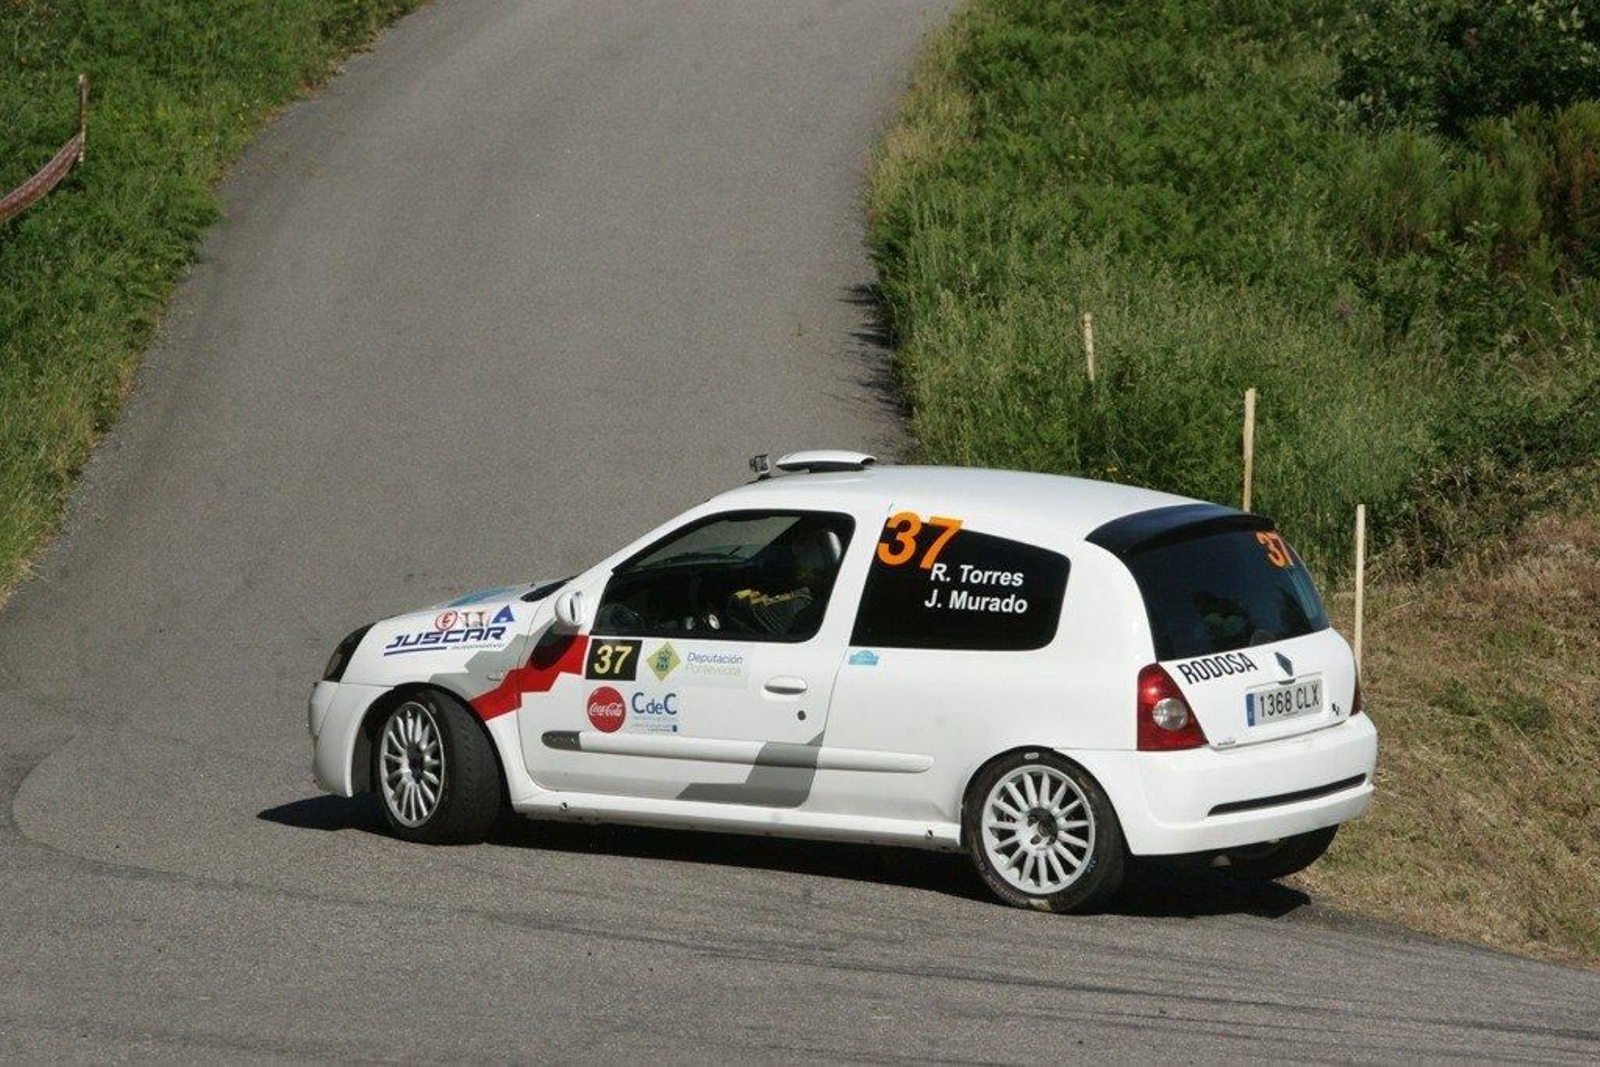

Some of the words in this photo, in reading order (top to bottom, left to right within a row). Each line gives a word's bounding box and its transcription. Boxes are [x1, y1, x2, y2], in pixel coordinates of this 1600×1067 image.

[877, 511, 964, 569] 37
[1255, 530, 1294, 567] 37
[930, 563, 951, 582] R.
[960, 565, 1024, 587] Torres
[924, 589, 942, 608] J.
[949, 590, 1028, 614] Murado
[385, 626, 507, 649] JUSCAR
[593, 644, 634, 675] 37
[687, 651, 743, 665] Deputación
[1177, 652, 1259, 685] RODOSA
[1260, 689, 1293, 718] 1368
[1296, 684, 1320, 710] CLX
